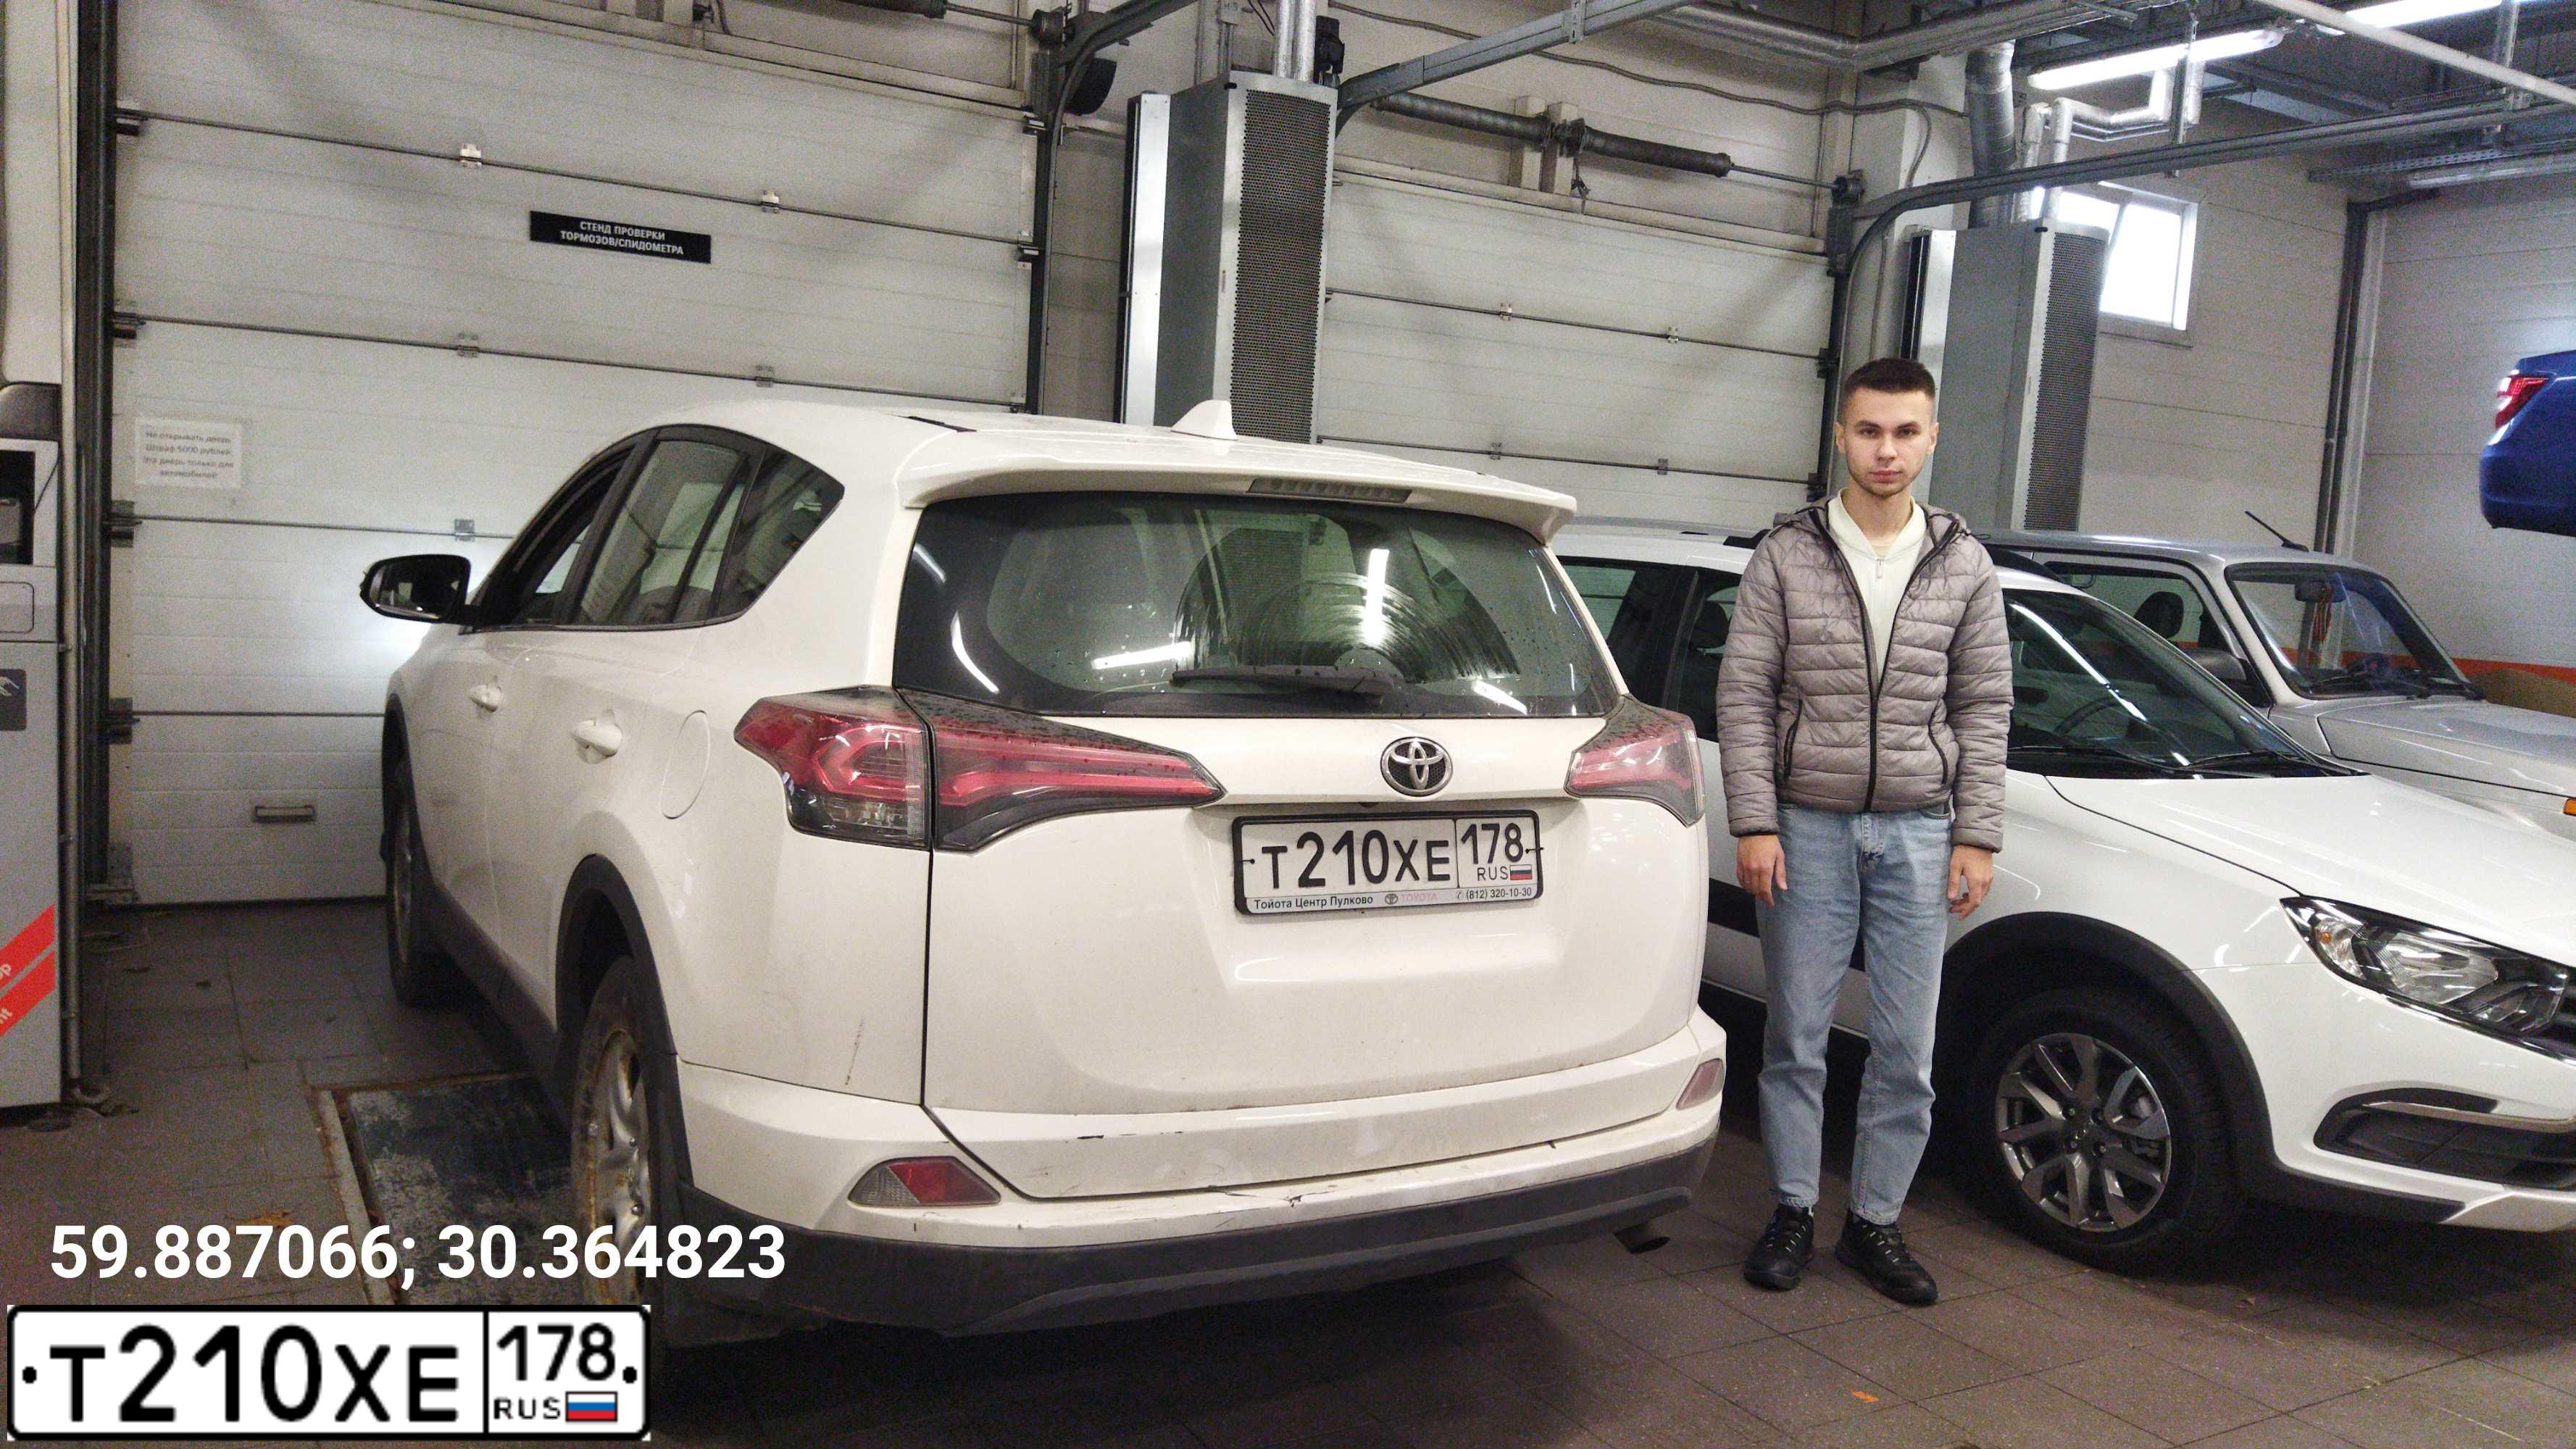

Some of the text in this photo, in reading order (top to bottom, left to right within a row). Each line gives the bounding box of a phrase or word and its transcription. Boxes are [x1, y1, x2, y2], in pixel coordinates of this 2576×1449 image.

[580, 221, 665, 241] СТЕНД ПРОВЕРКИ
[560, 230, 684, 255] ТОРМОЗОВ/СПИДОМЕТРА
[1461, 823, 1523, 864] 178
[1477, 866, 1509, 881] RUS
[1401, 893, 1438, 902] TOYOTA
[1466, 888, 1532, 900] (812) 320-10-30
[1254, 895, 1373, 909] Тойота Центр Пулково
